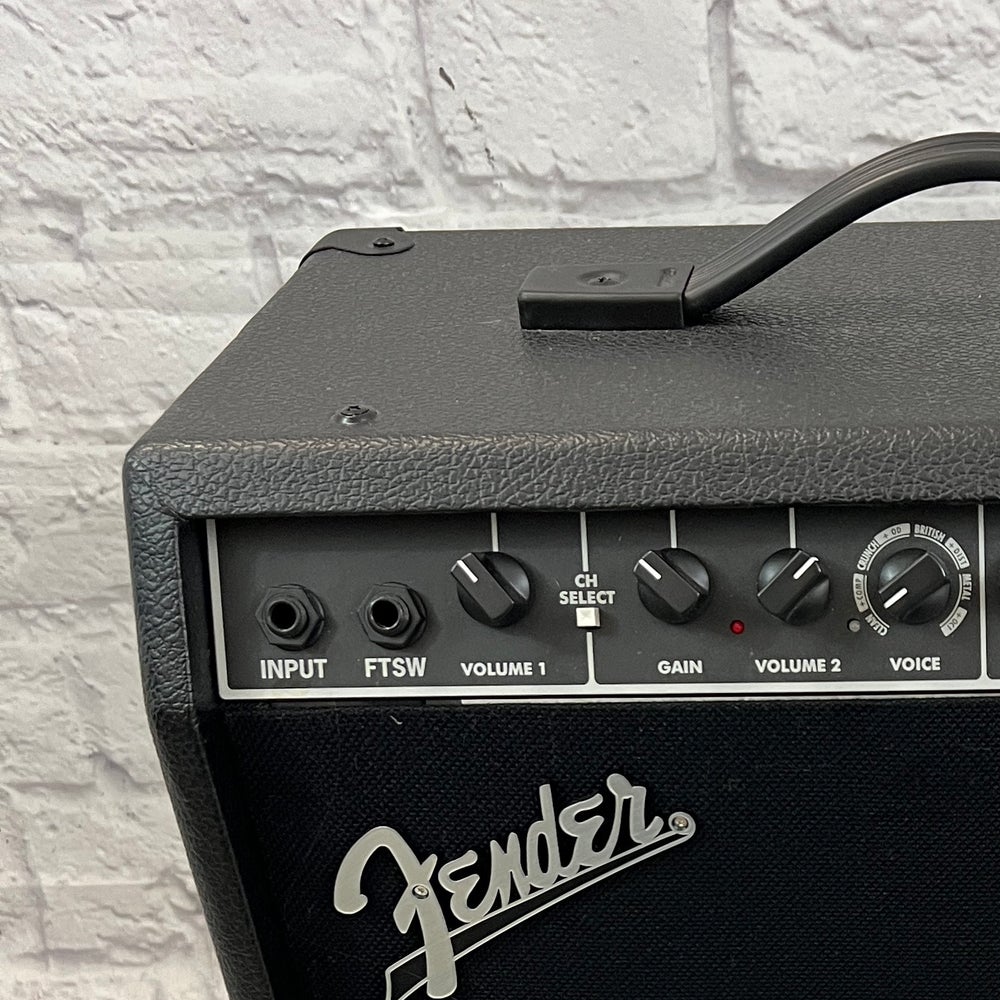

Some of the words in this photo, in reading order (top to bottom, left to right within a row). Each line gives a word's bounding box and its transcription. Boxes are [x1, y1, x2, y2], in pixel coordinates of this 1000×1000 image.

[914, 524, 946, 542] BRITISH
[857, 540, 879, 570] CRUNCH
[574, 574, 598, 588] CH
[962, 573, 972, 600] METAL
[559, 590, 616, 605] SELECT
[865, 614, 888, 636] CLEAN
[260, 658, 328, 679] INPUT
[364, 657, 427, 678] FTSW
[460, 662, 533, 677] VOLUME
[537, 662, 546, 676] 1
[657, 659, 704, 675] GAIN
[754, 658, 827, 674] VOLUME
[830, 658, 842, 672] 2
[889, 657, 941, 671] VOICE
